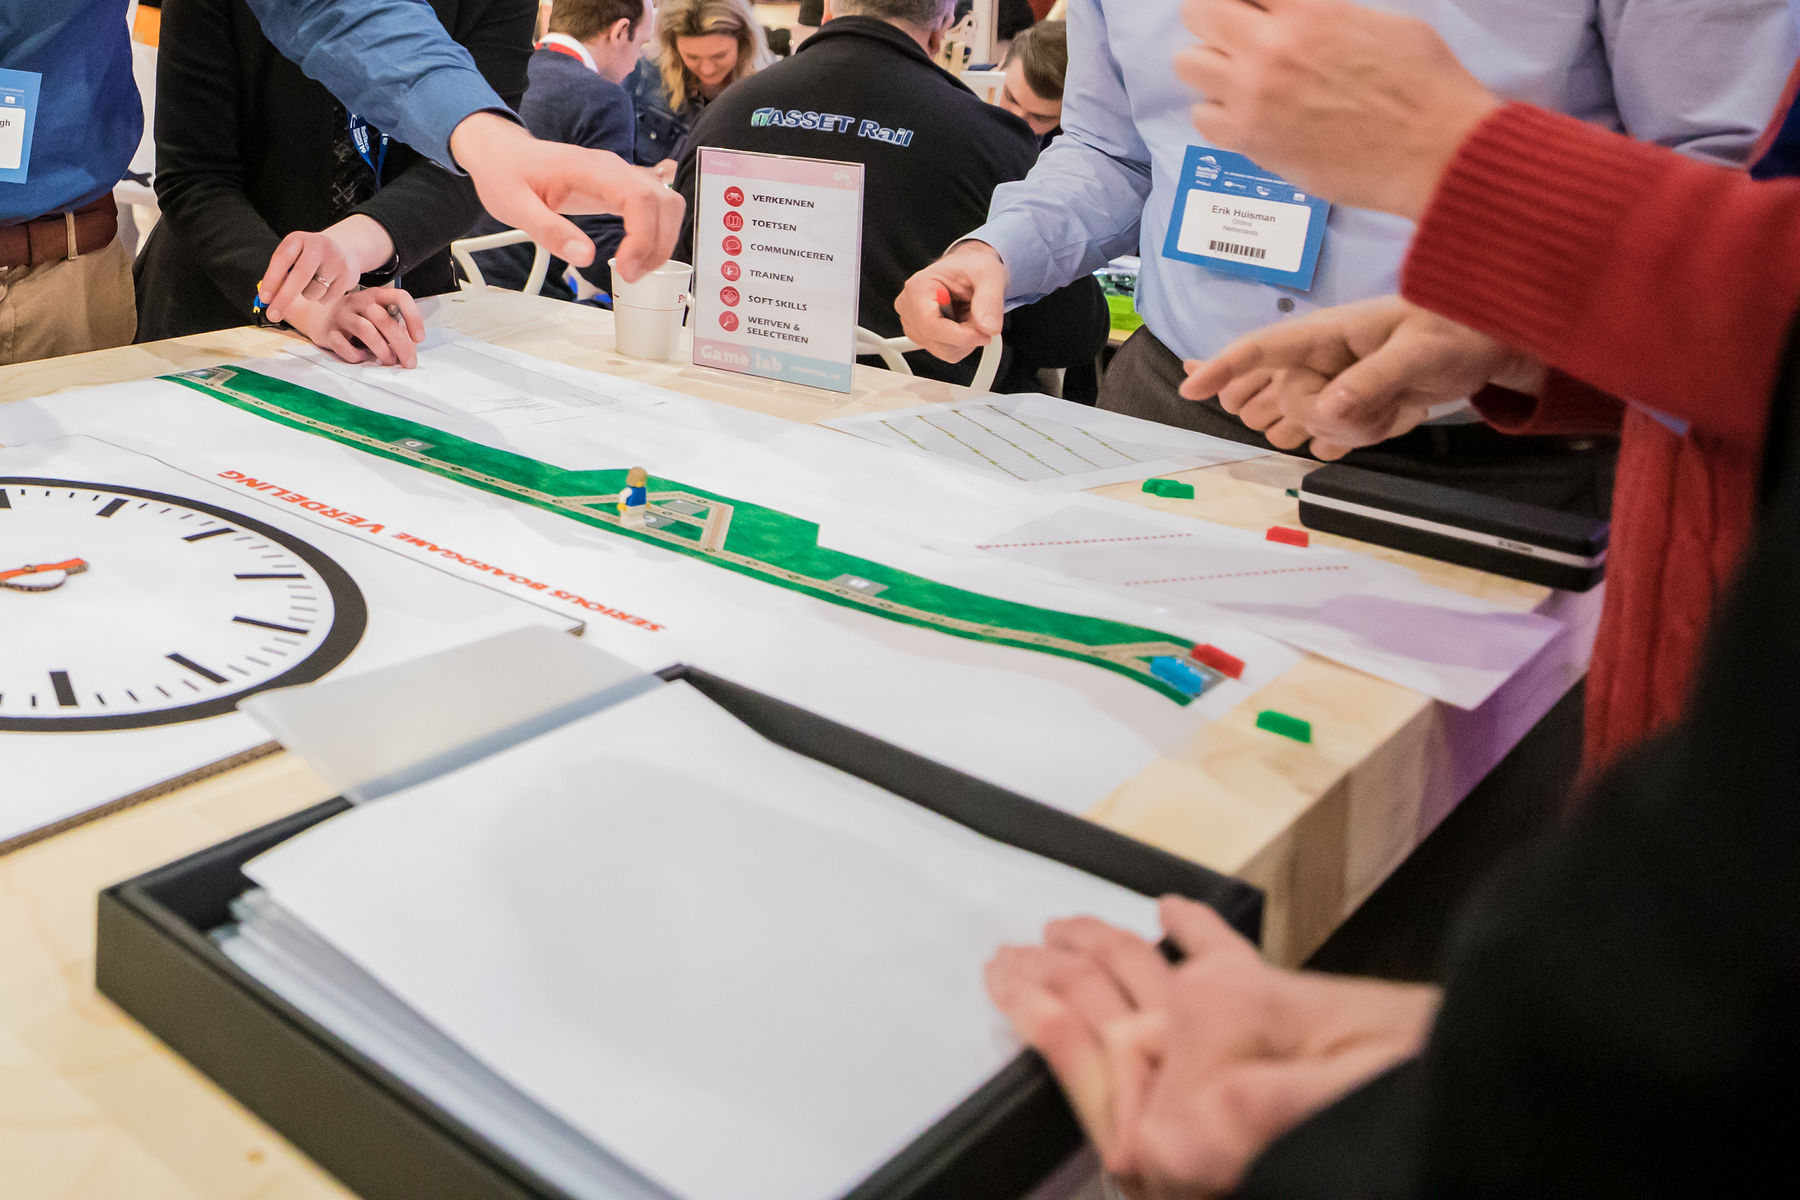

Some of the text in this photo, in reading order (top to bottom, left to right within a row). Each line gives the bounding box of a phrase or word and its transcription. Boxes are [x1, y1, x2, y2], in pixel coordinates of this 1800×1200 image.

[767, 110, 915, 148] ASSET Rail
[751, 193, 815, 209] VERKENNEN
[1233, 208, 1276, 223] Huisman
[751, 218, 797, 232] TOETSEN
[750, 242, 834, 262] COMMUNICEREN
[749, 268, 794, 283] TRAINEN
[748, 294, 808, 312] SOFT SKILLS
[747, 315, 801, 332] WERVEN &
[746, 326, 809, 344] SELECTEREN
[700, 343, 750, 367] Game
[754, 351, 783, 373] lab
[216, 469, 667, 632] SERIOUS BOARDGAME VERDELING
